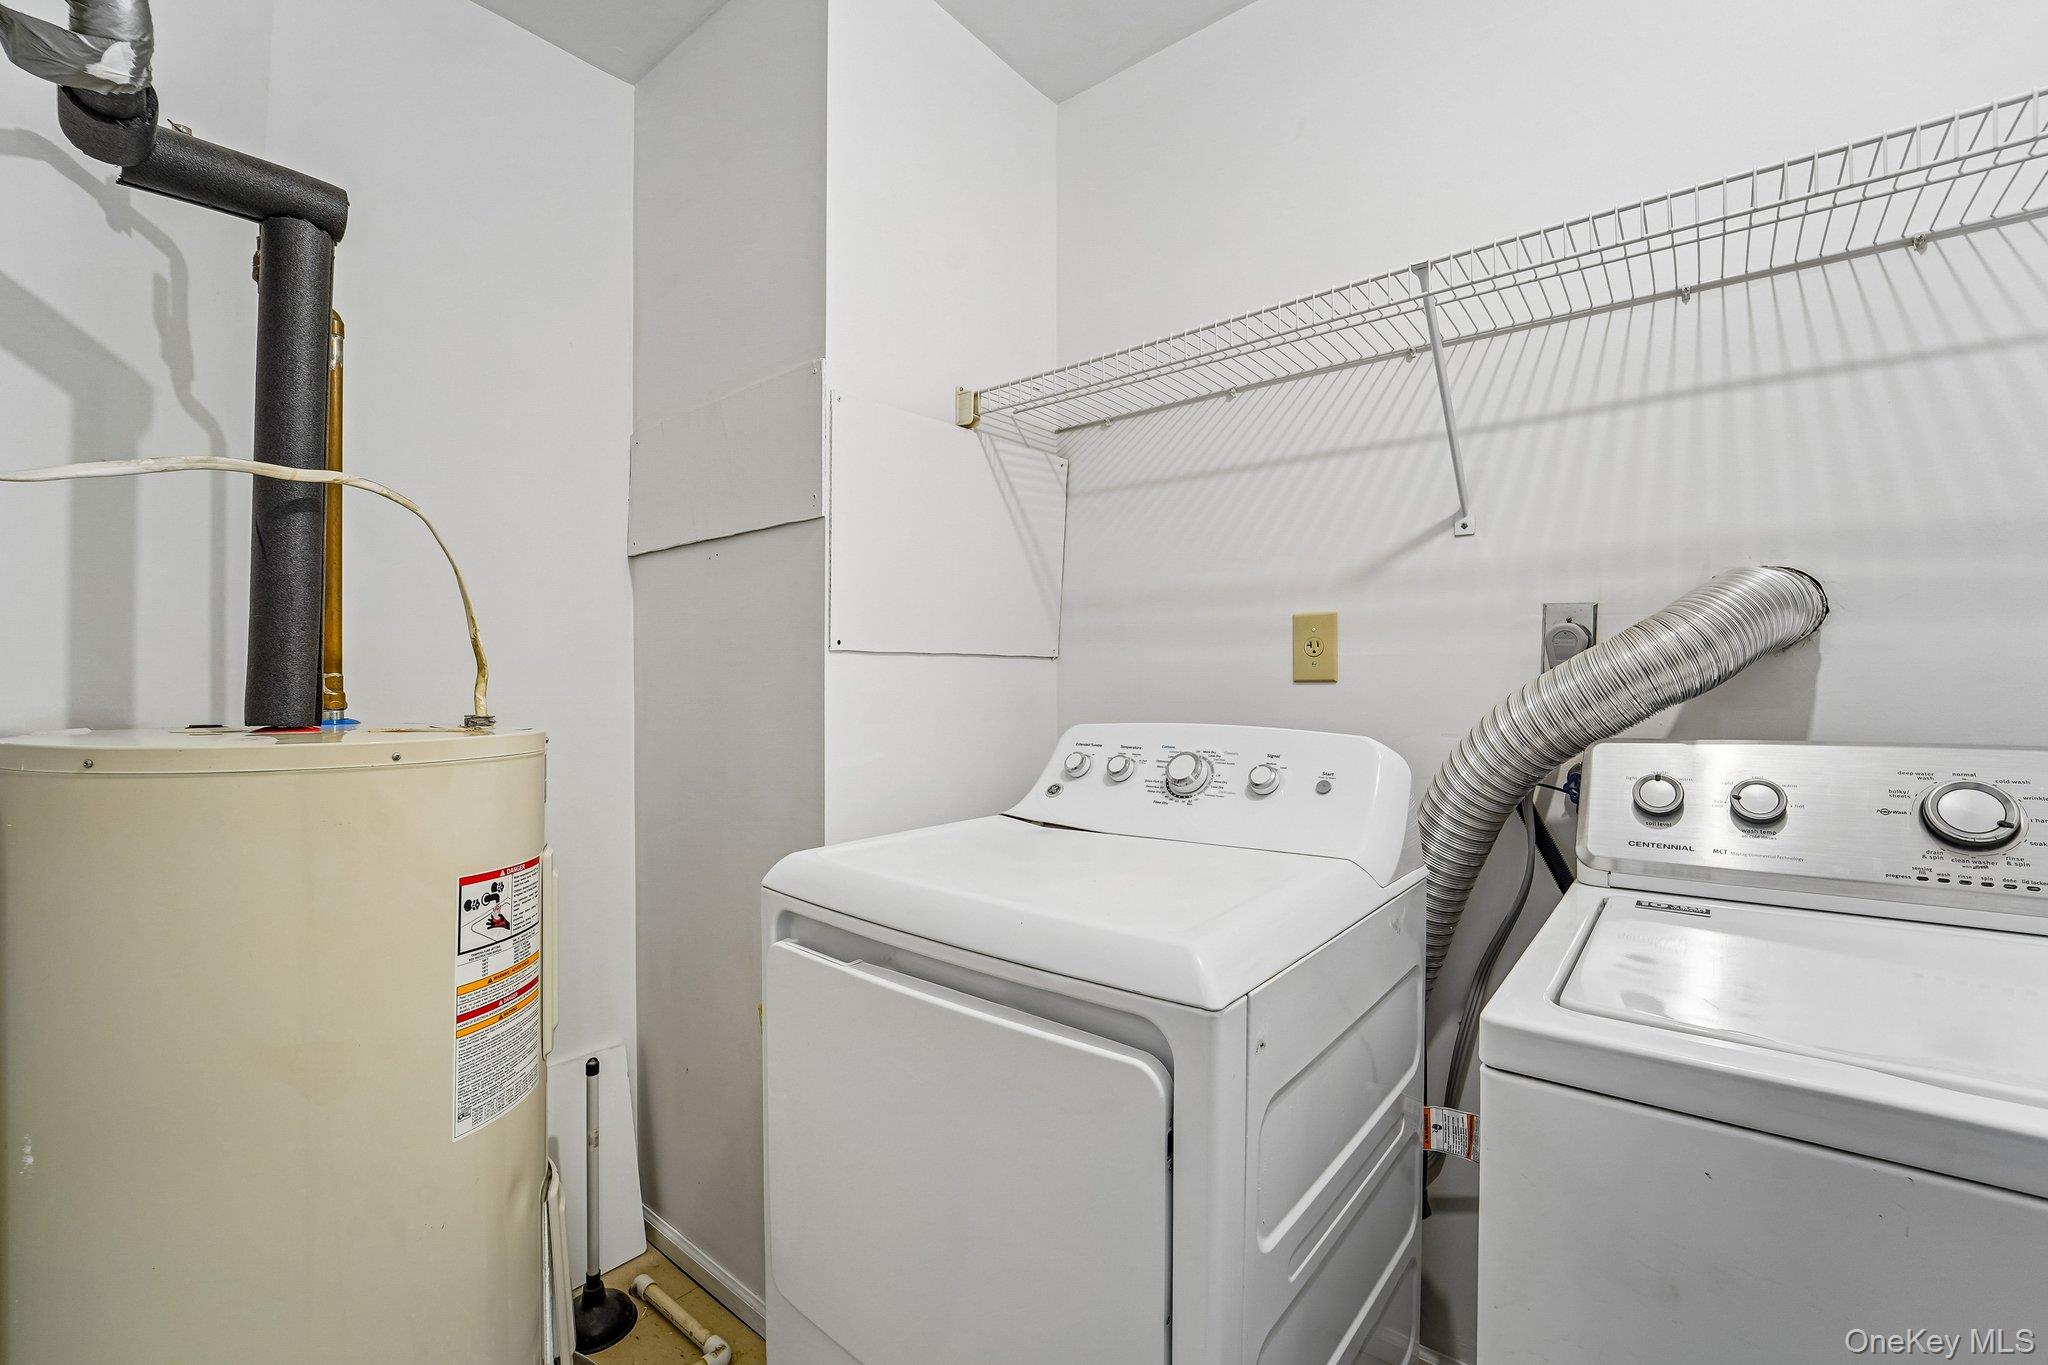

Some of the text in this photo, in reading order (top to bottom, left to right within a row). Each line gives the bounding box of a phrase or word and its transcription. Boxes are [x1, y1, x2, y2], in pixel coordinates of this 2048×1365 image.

[1628, 840, 1695, 852] CENTENNIAL
[506, 863, 526, 875] DANGER
[503, 991, 519, 1004] DANGER
